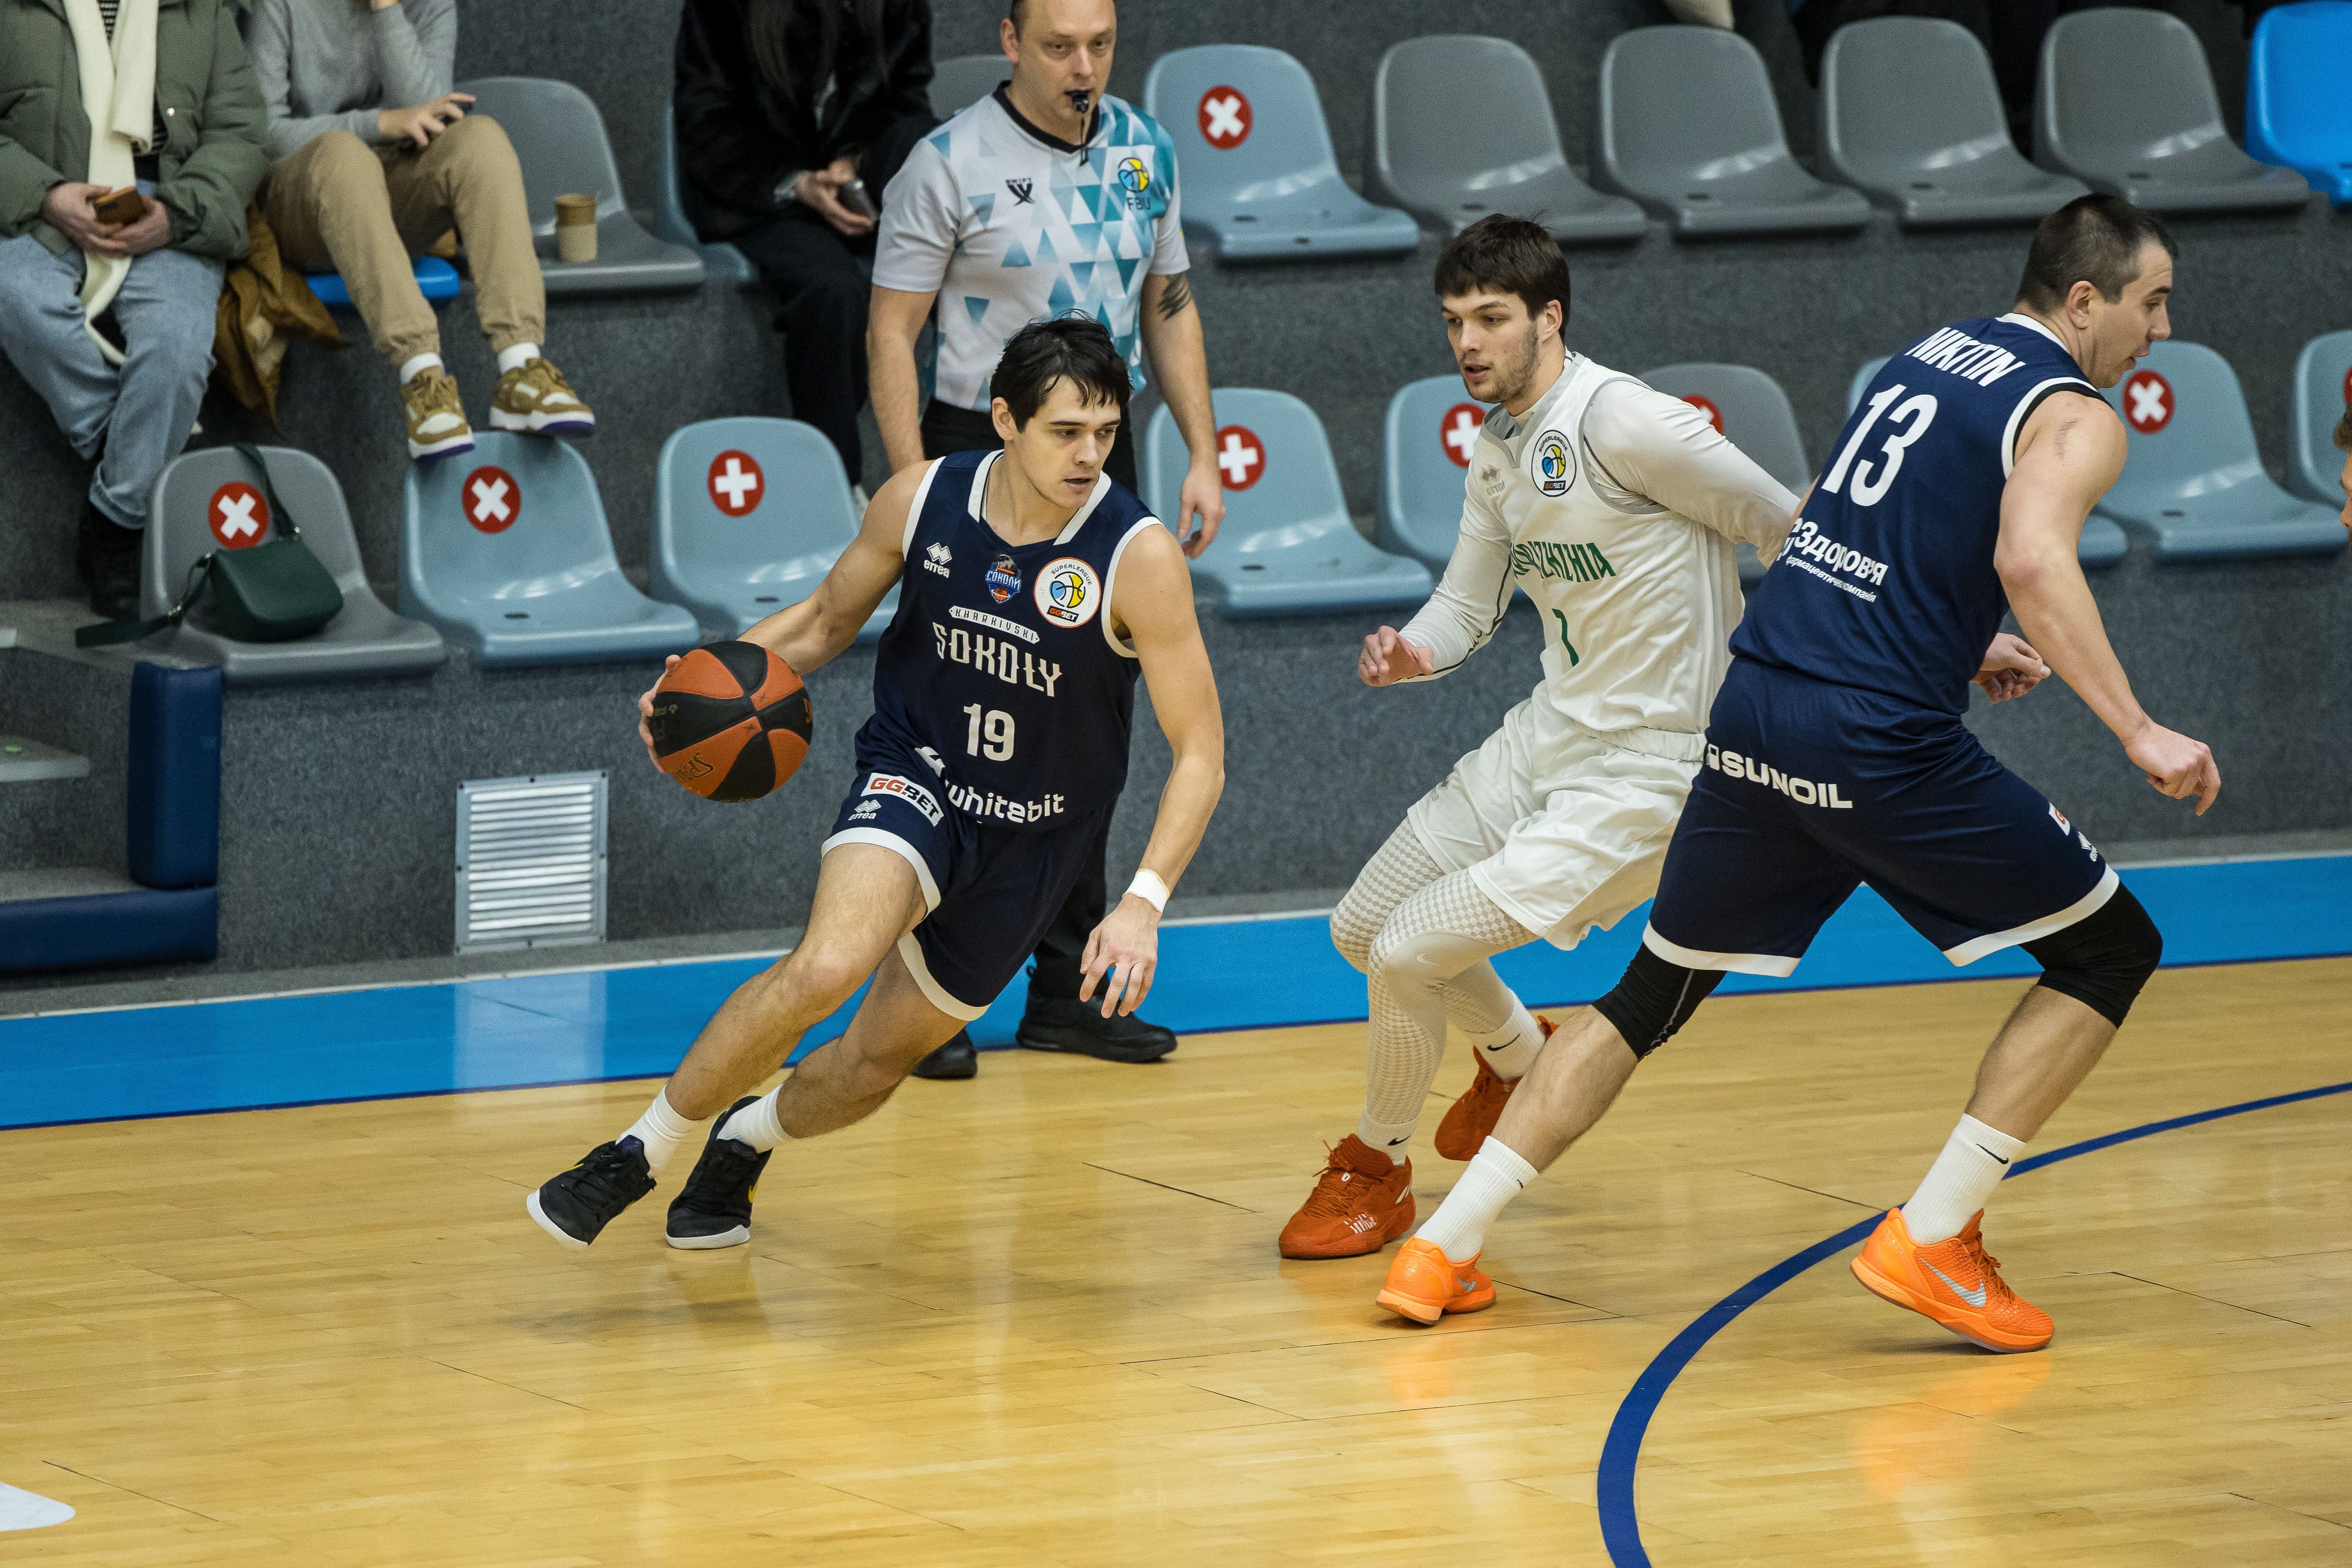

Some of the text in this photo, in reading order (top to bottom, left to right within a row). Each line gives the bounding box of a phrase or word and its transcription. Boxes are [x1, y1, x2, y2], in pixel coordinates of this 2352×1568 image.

[1127, 197, 1151, 210] FBU
[1903, 327, 2027, 387] NIKITIN
[1538, 435, 1568, 453] SUPERLEAGUE
[1821, 383, 1938, 507] 13
[923, 559, 950, 578] errea
[1051, 564, 1093, 585] SUPERLEAGUE
[955, 608, 1034, 641] KHARKIVSKI
[933, 622, 1063, 697] SOKOLY
[964, 703, 1015, 762] 19
[871, 777, 939, 818] GG.BET
[1721, 750, 1853, 808] SUNOIL
